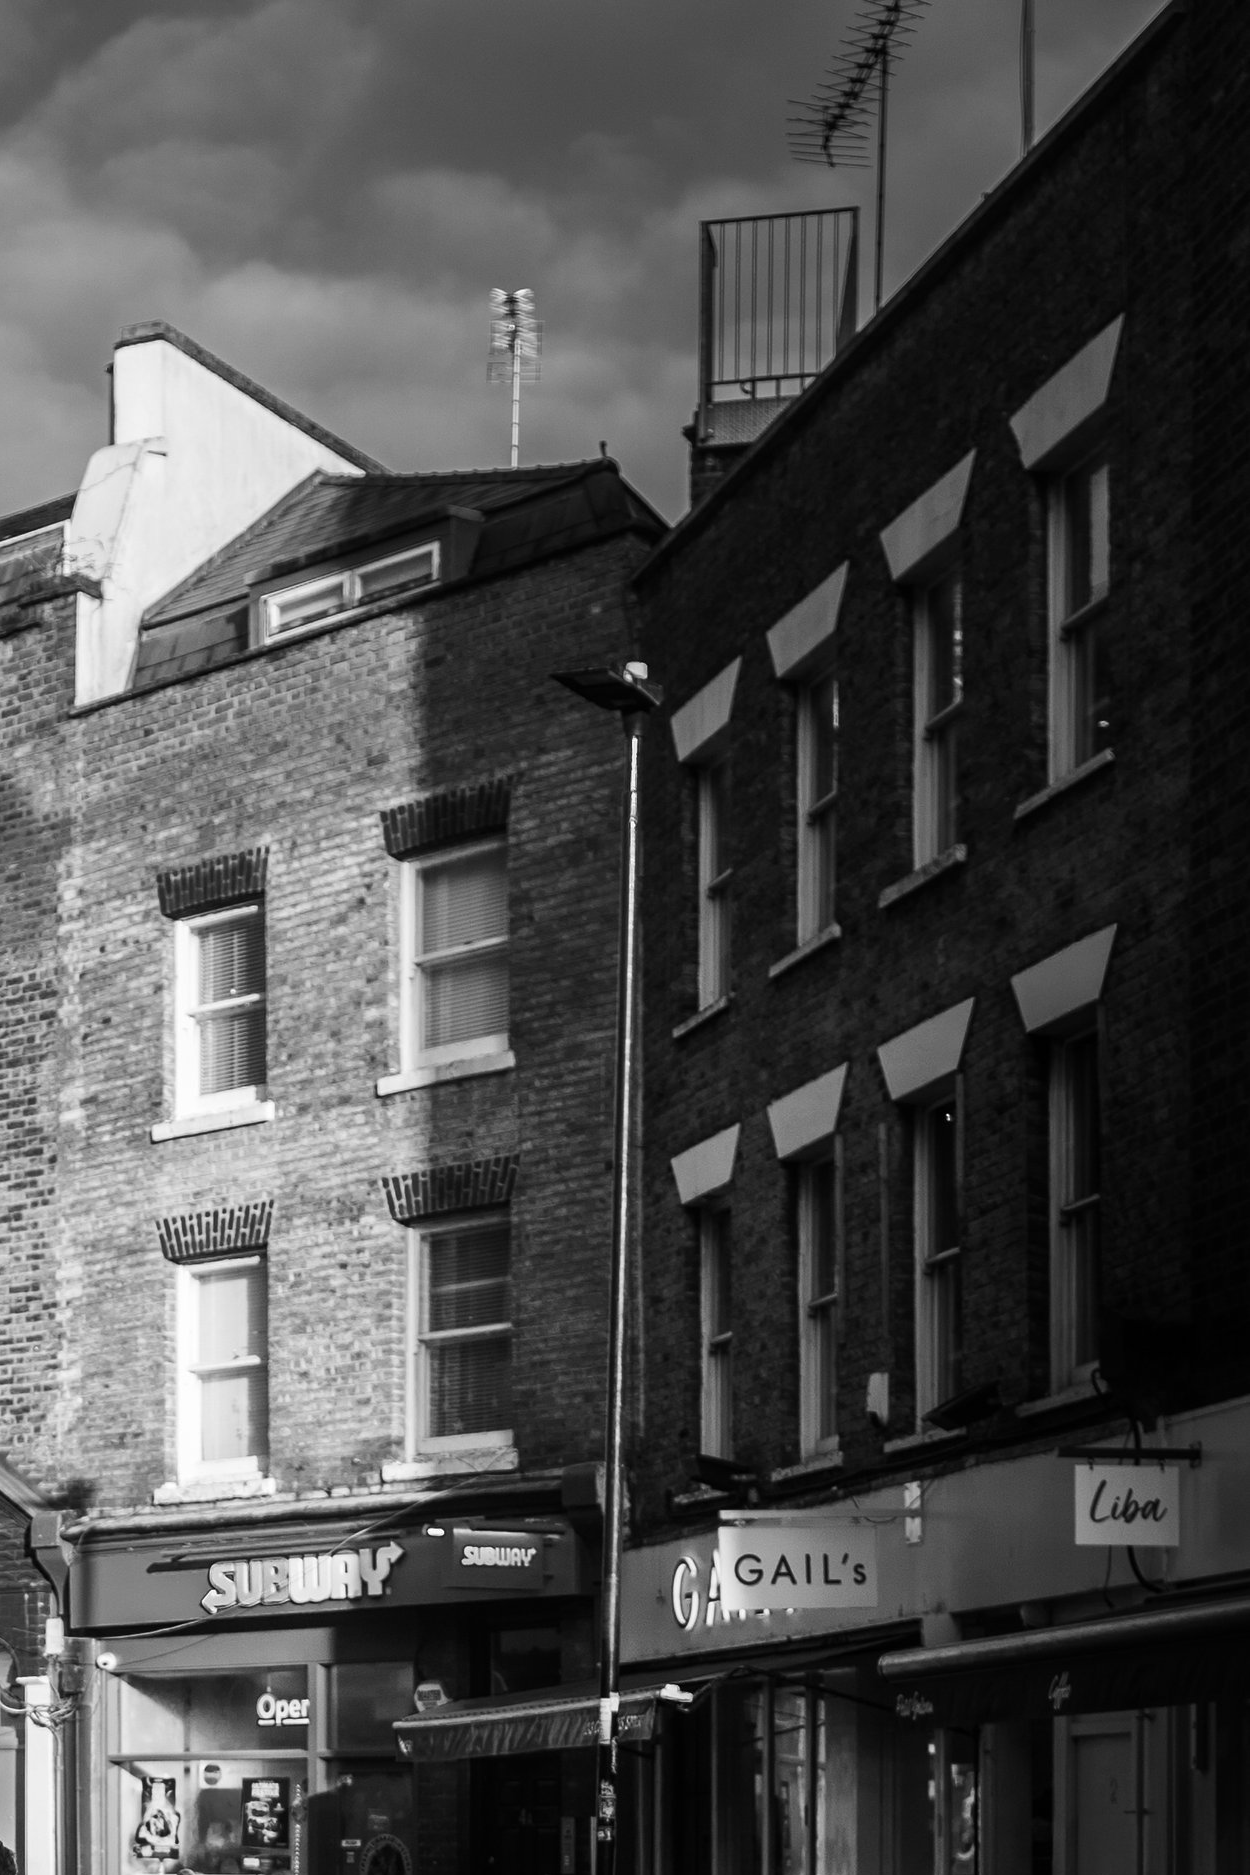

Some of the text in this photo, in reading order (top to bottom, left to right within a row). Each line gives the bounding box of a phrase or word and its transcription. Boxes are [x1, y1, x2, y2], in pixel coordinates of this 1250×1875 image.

[1089, 1479, 1168, 1524] Liba
[461, 1546, 537, 1567] SUBWAY
[734, 1553, 867, 1586] GAIL's
[201, 1541, 405, 1614] SUBWAY
